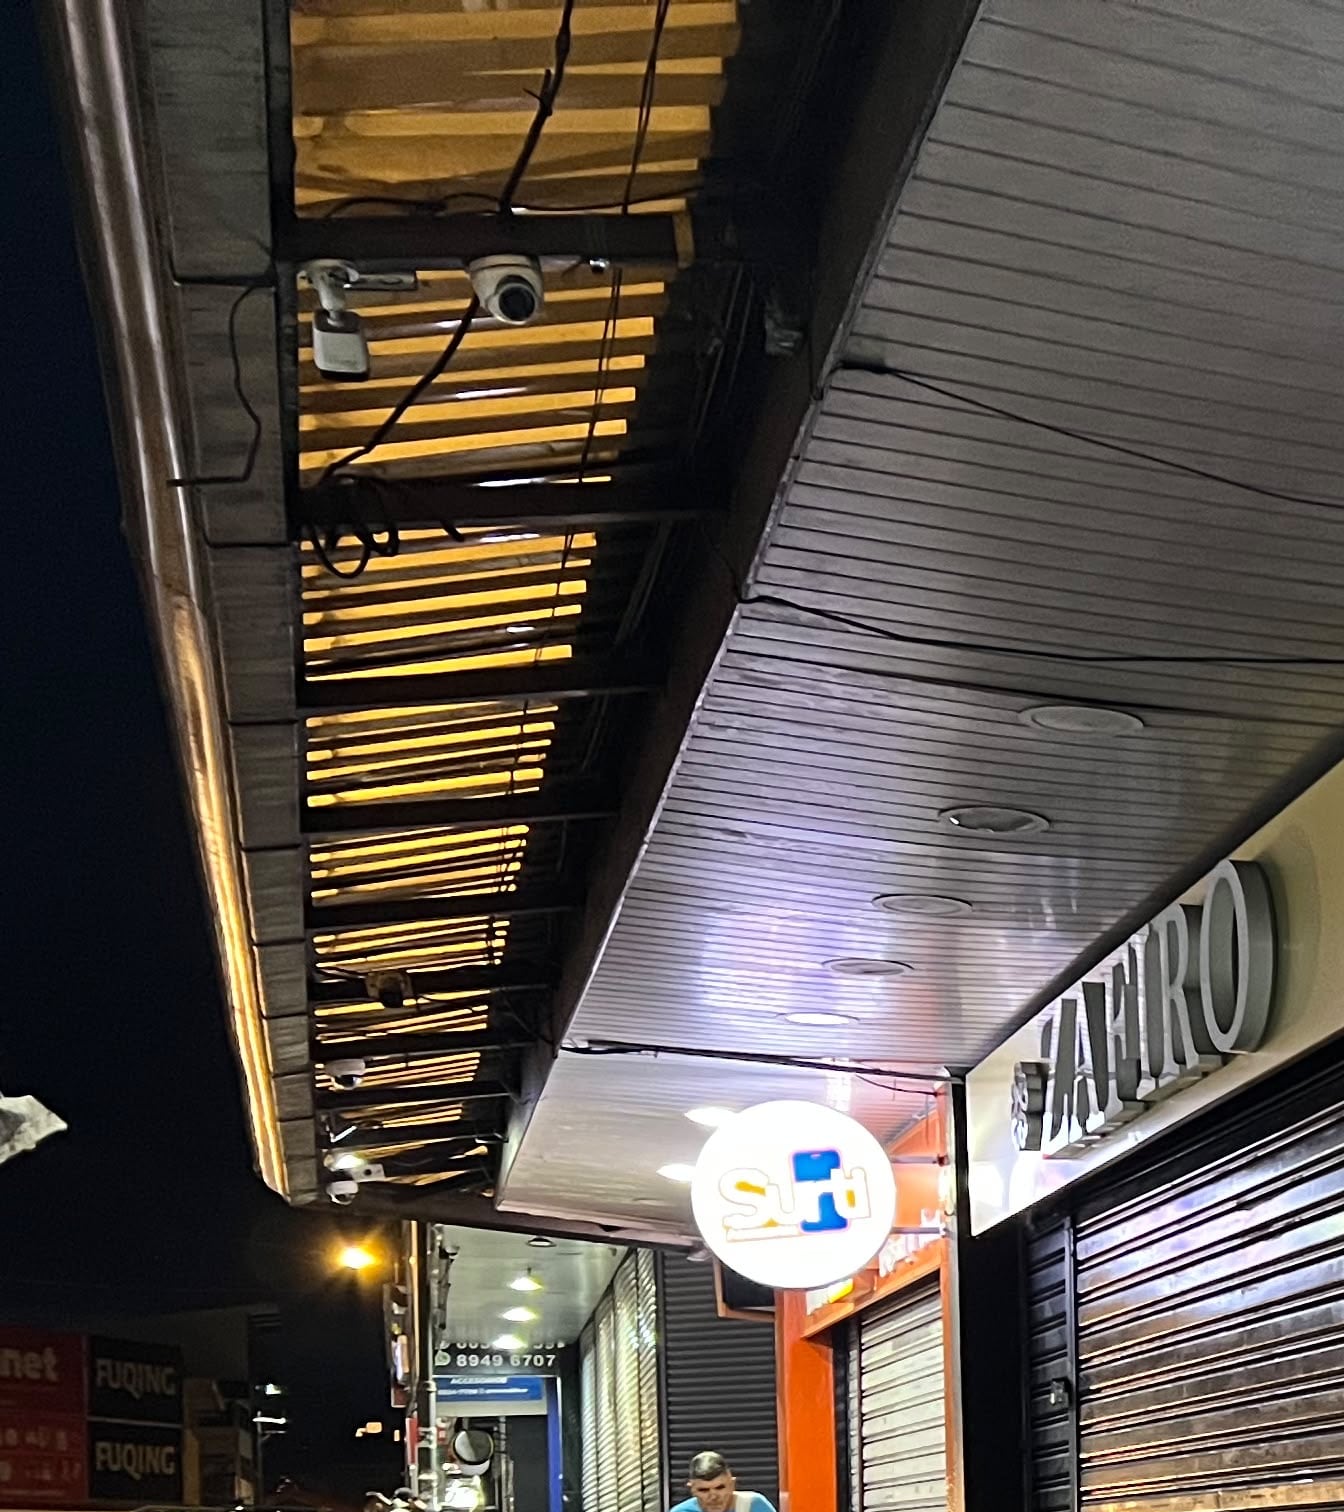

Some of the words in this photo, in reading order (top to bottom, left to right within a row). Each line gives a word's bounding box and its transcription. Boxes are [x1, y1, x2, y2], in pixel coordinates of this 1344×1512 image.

[96, 1357, 176, 1400] FUQING
[456, 1354, 503, 1367] 8949
[509, 1354, 556, 1367] 6707
[95, 1440, 176, 1481] FUQING
